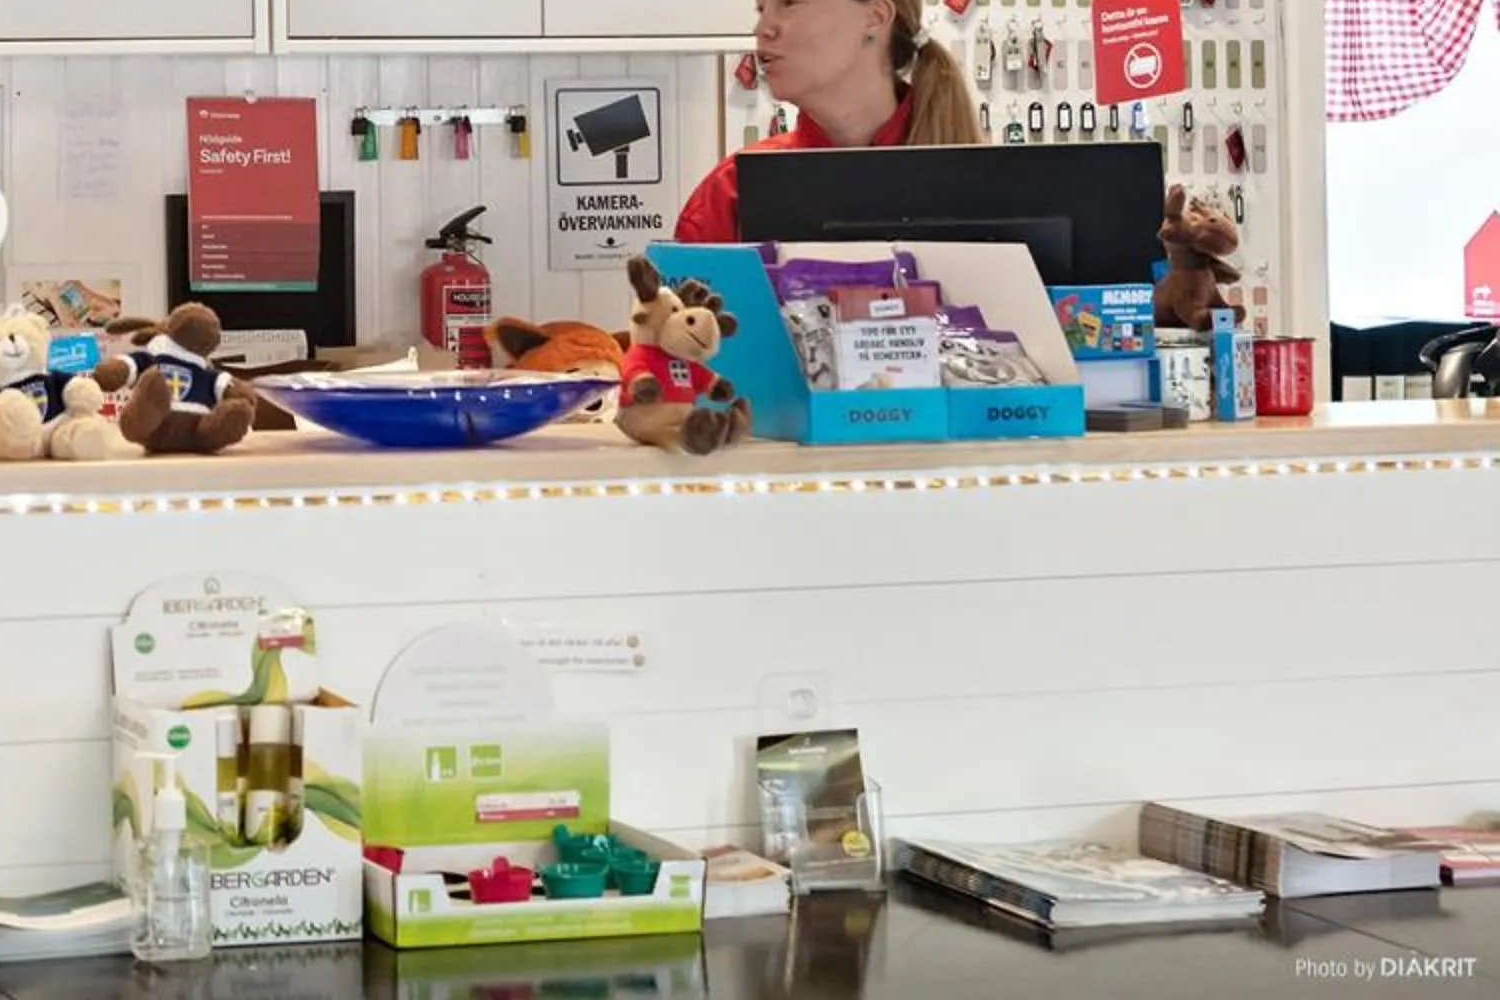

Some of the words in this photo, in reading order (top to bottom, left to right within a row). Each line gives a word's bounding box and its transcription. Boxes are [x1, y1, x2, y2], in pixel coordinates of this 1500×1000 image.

[200, 148, 250, 167] Safety
[253, 149, 291, 164] First!
[576, 194, 644, 211] KAMERA-
[558, 211, 663, 231] ÖVERVAKNING
[848, 408, 914, 424] DOGGY
[986, 405, 1052, 421] DOGGY
